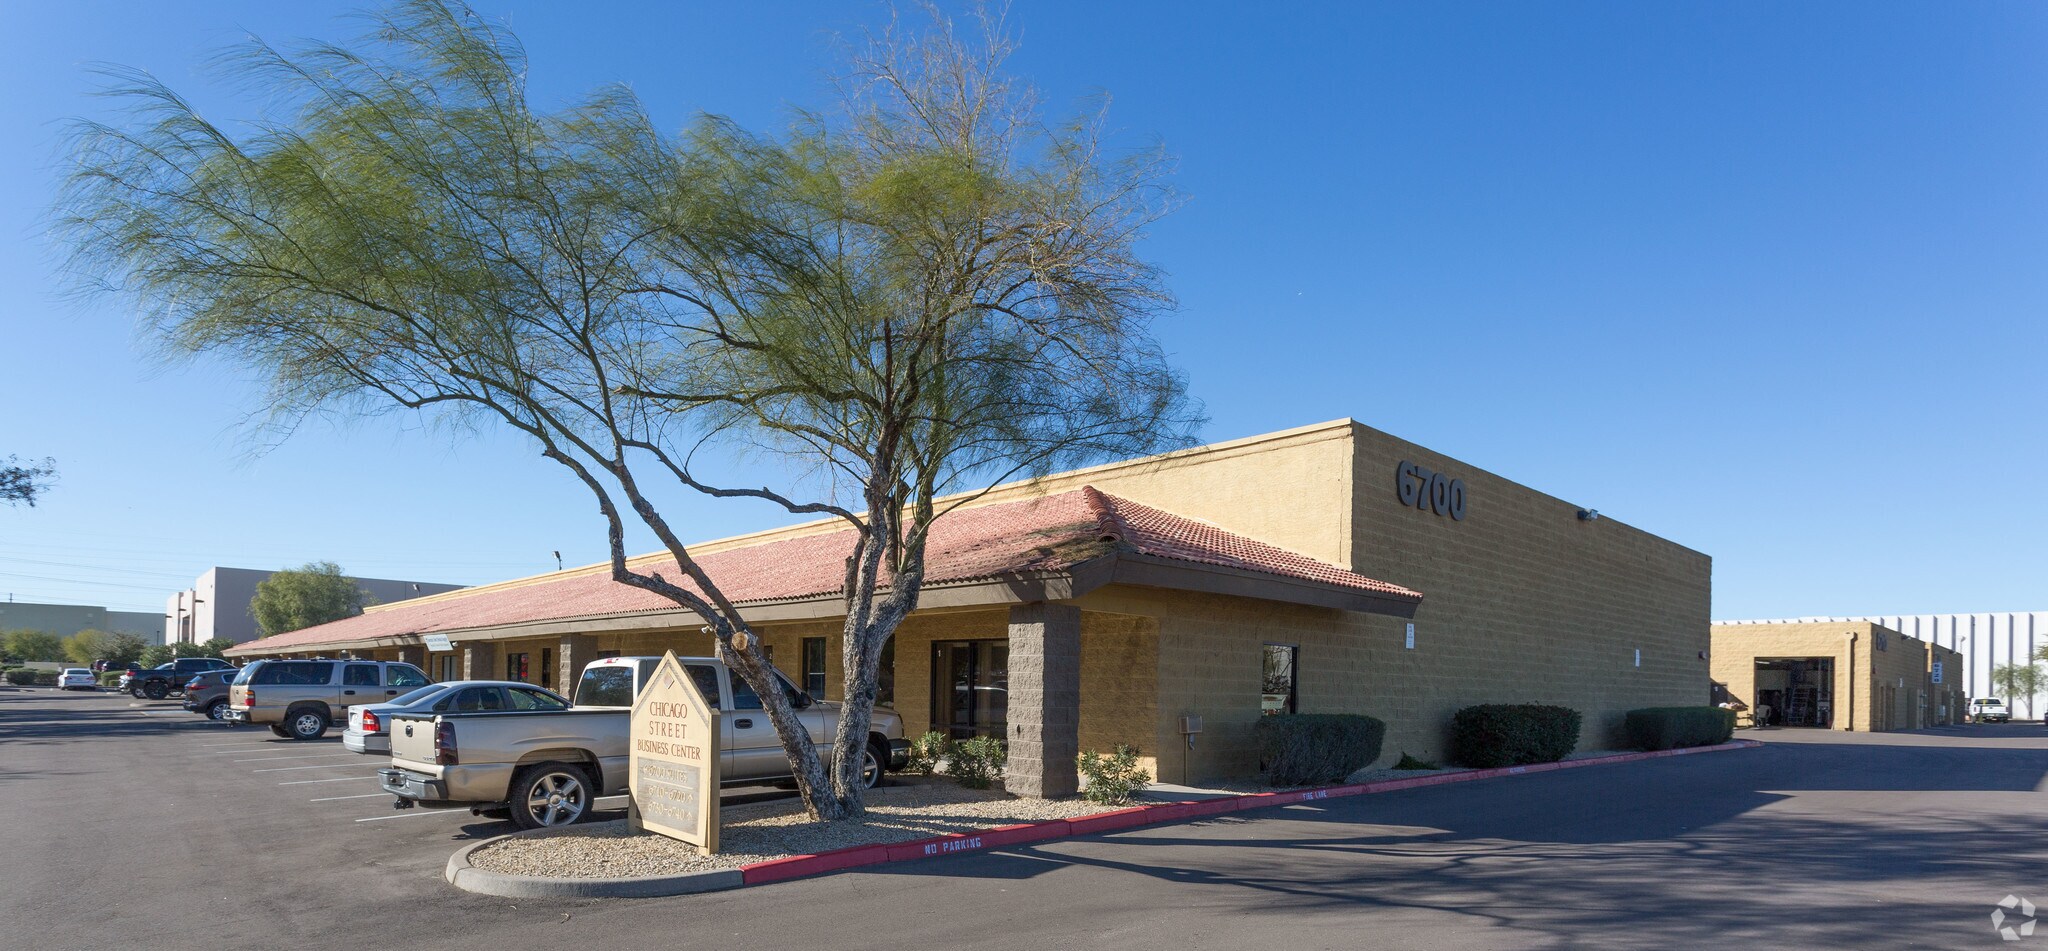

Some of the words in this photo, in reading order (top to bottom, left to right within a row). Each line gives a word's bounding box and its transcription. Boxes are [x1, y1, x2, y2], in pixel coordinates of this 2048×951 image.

[1396, 460, 1466, 521] 6700
[650, 701, 687, 719] CHICAGO
[649, 720, 687, 739] STREET
[637, 739, 668, 756] BUSINESS
[671, 743, 701, 760] CENTER
[925, 844, 937, 854] NO
[943, 837, 981, 852] PARKING
